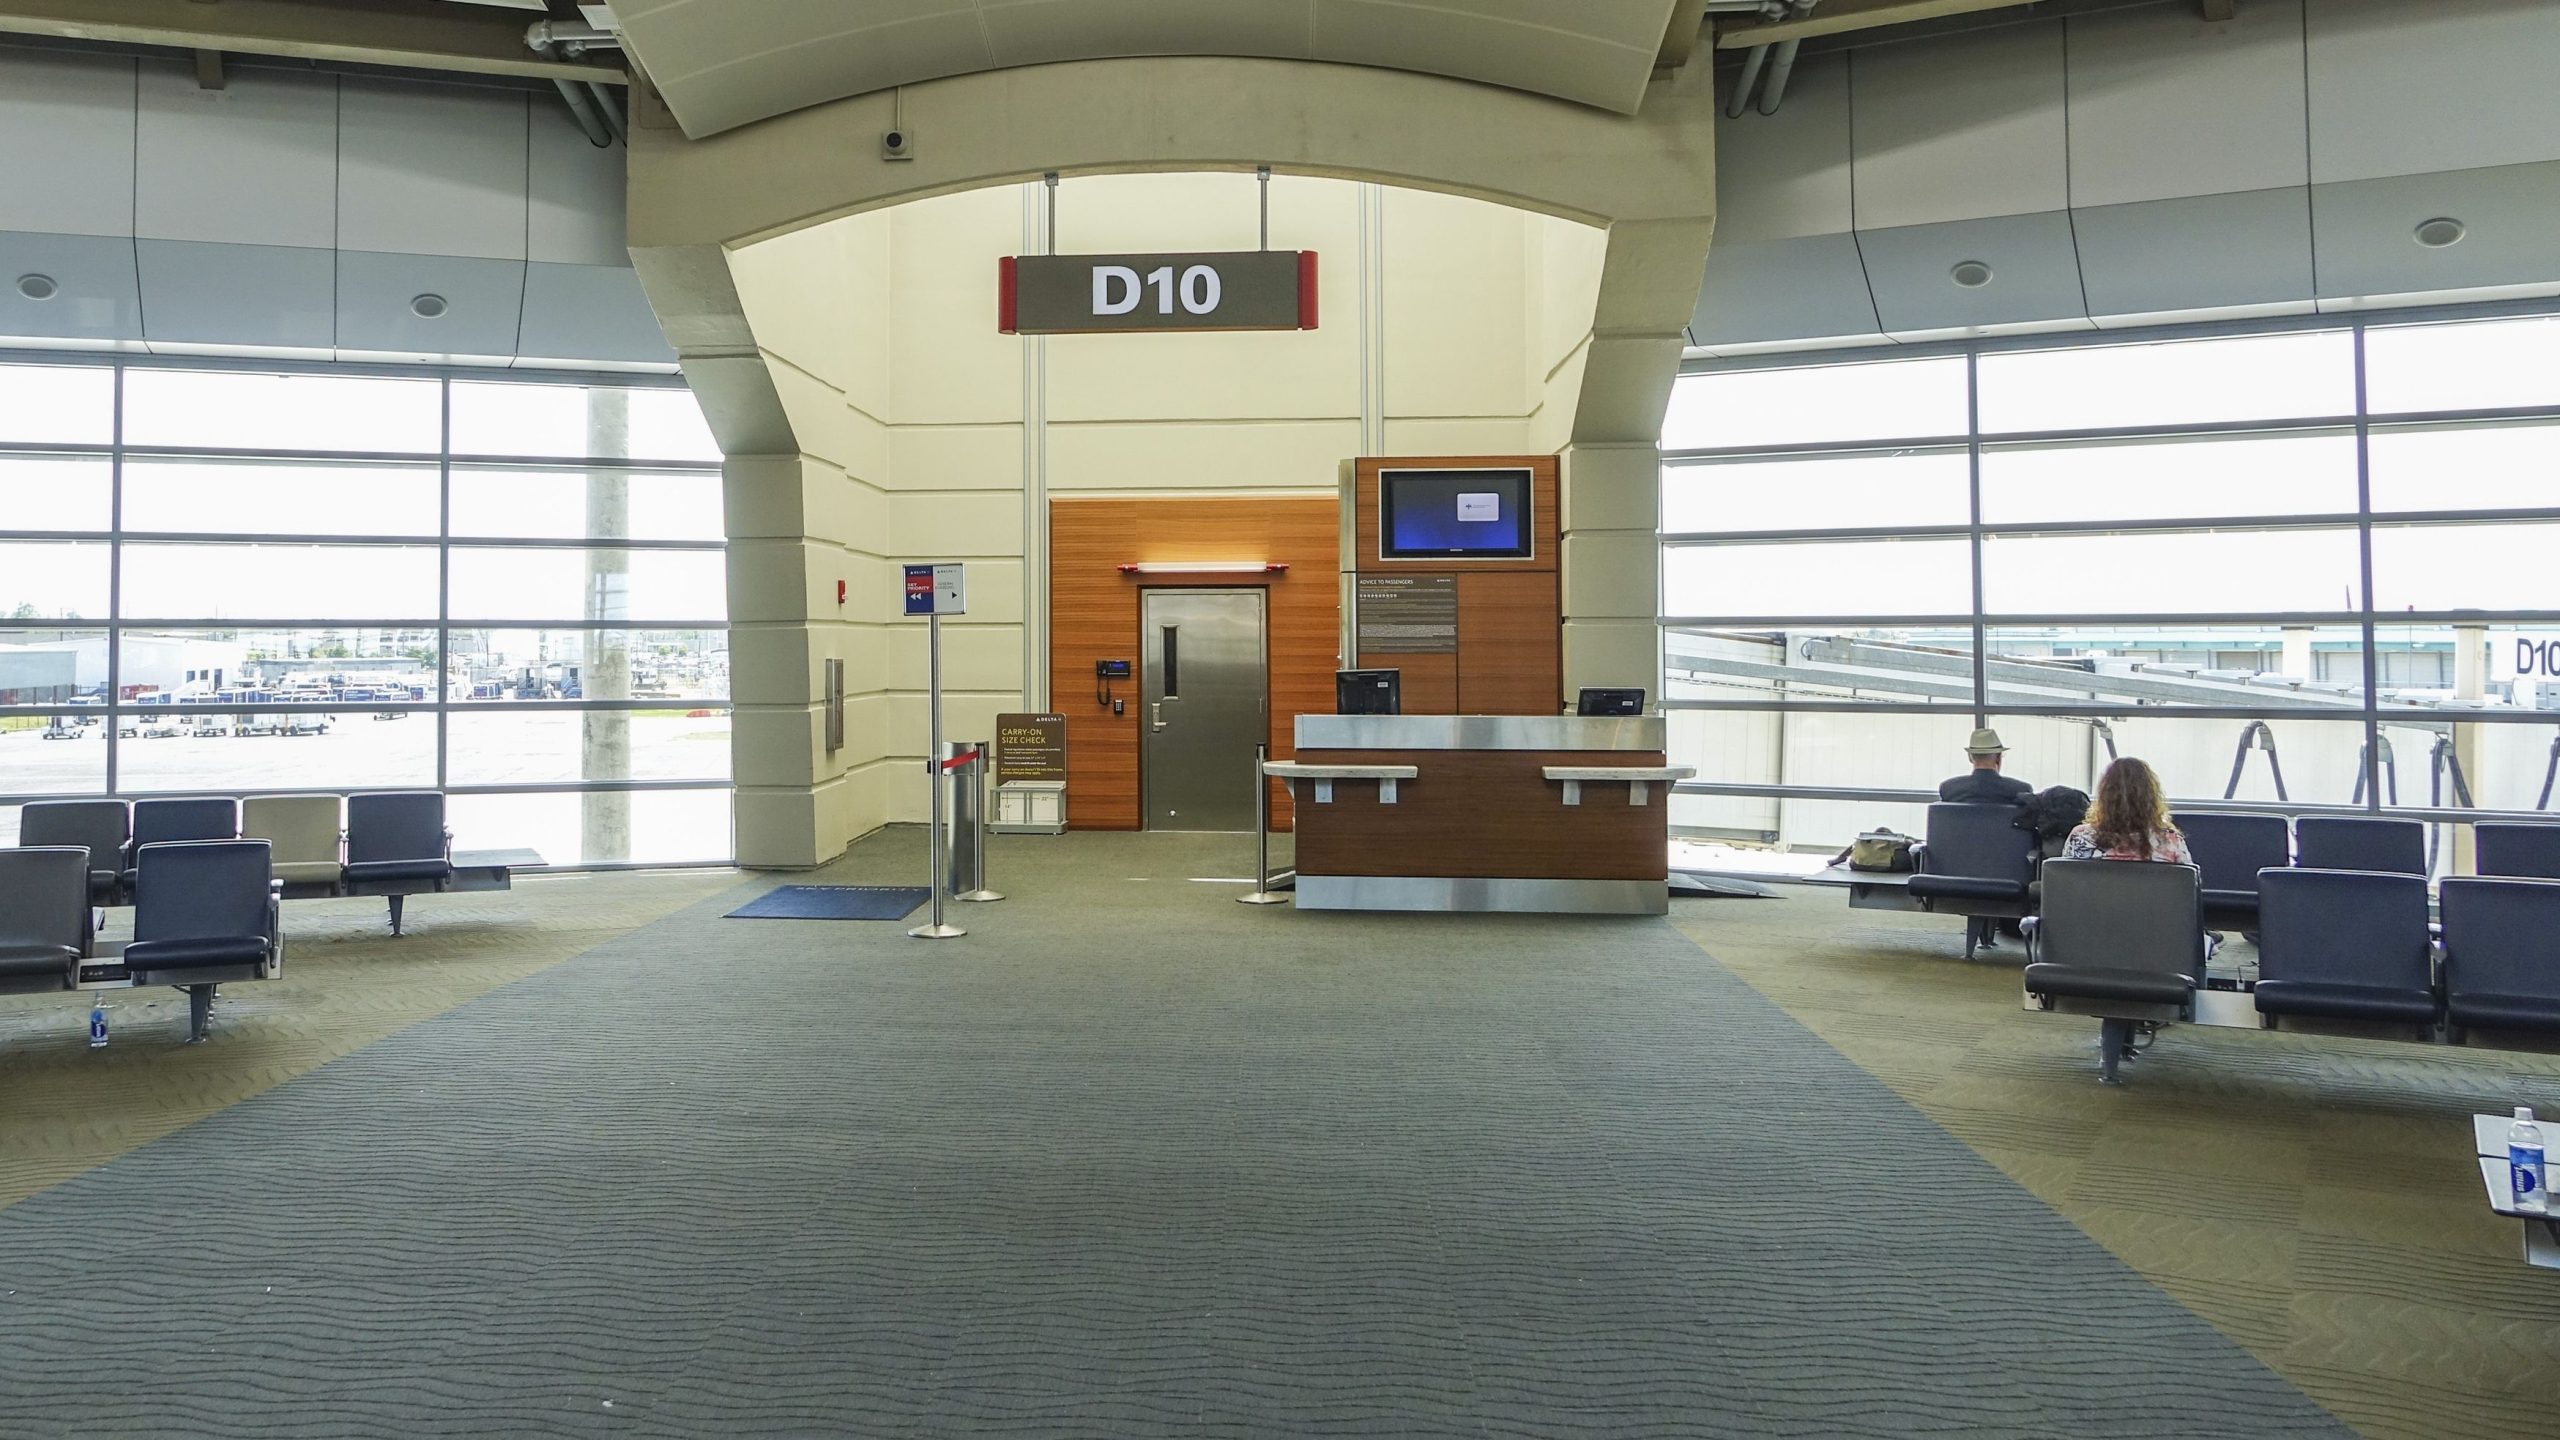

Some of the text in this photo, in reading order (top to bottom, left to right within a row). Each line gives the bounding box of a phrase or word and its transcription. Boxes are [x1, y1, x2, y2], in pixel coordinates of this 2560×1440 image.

[1092, 265, 1222, 316] D10
[2516, 638, 2560, 677] D10
[1001, 728, 1042, 736] CARRY-ON
